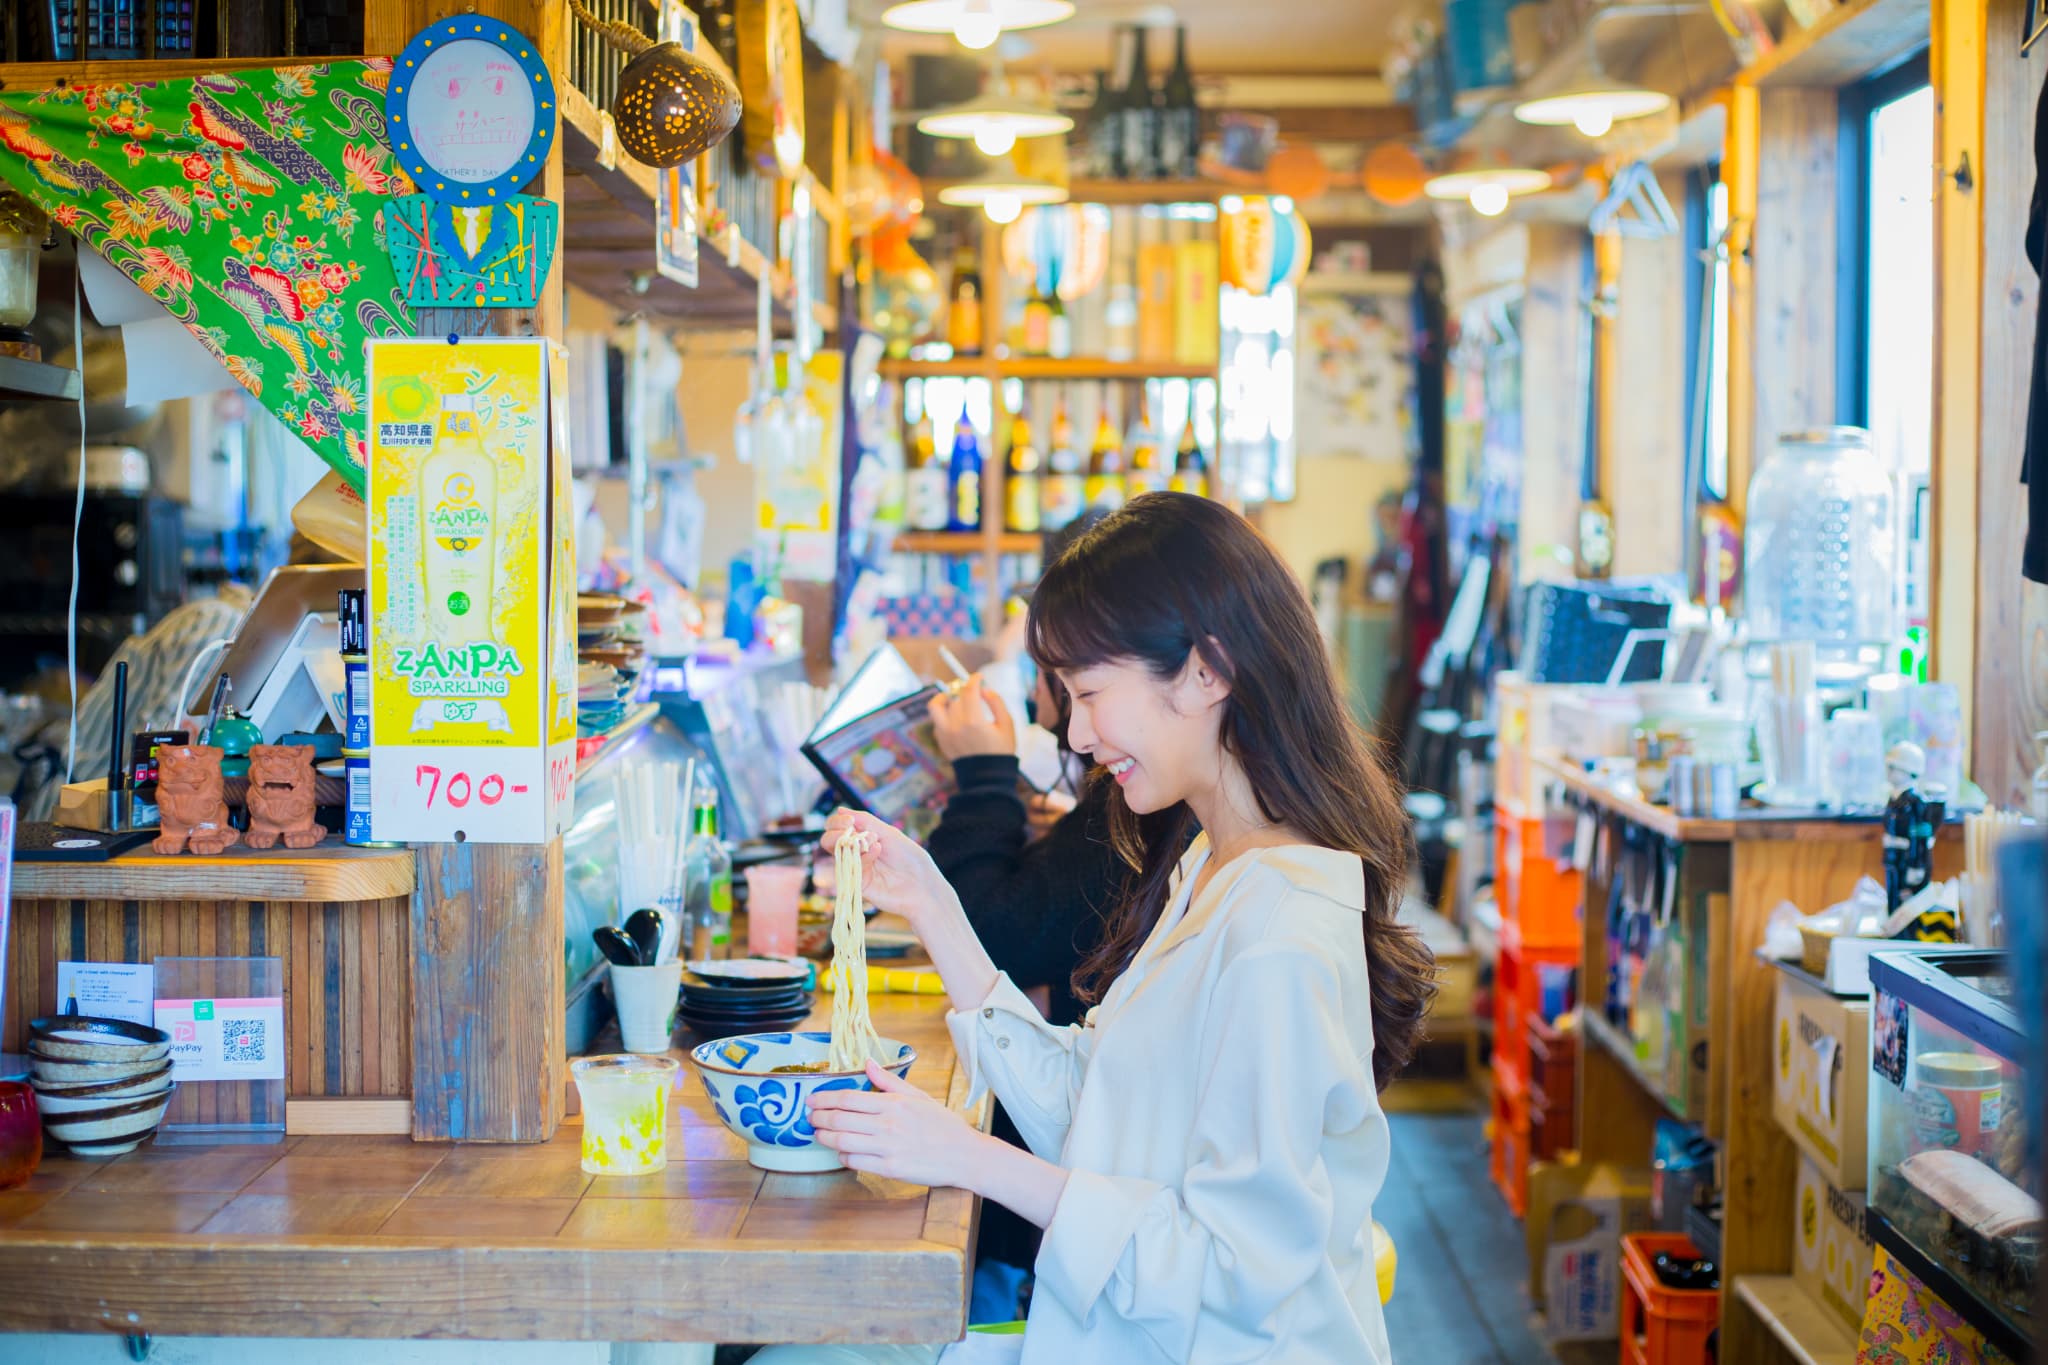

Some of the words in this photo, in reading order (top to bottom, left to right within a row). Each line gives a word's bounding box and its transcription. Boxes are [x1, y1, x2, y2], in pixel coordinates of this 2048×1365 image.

[482, 168, 499, 177] DAY
[380, 424, 432, 436] 高知県産
[428, 508, 489, 527] ZANPA
[449, 599, 469, 609] お酒
[396, 643, 519, 678] ZANPA
[412, 680, 505, 693] SPARKLING
[444, 702, 477, 720] ゆず
[416, 765, 529, 811] 700-
[169, 1044, 202, 1054] PayPay
